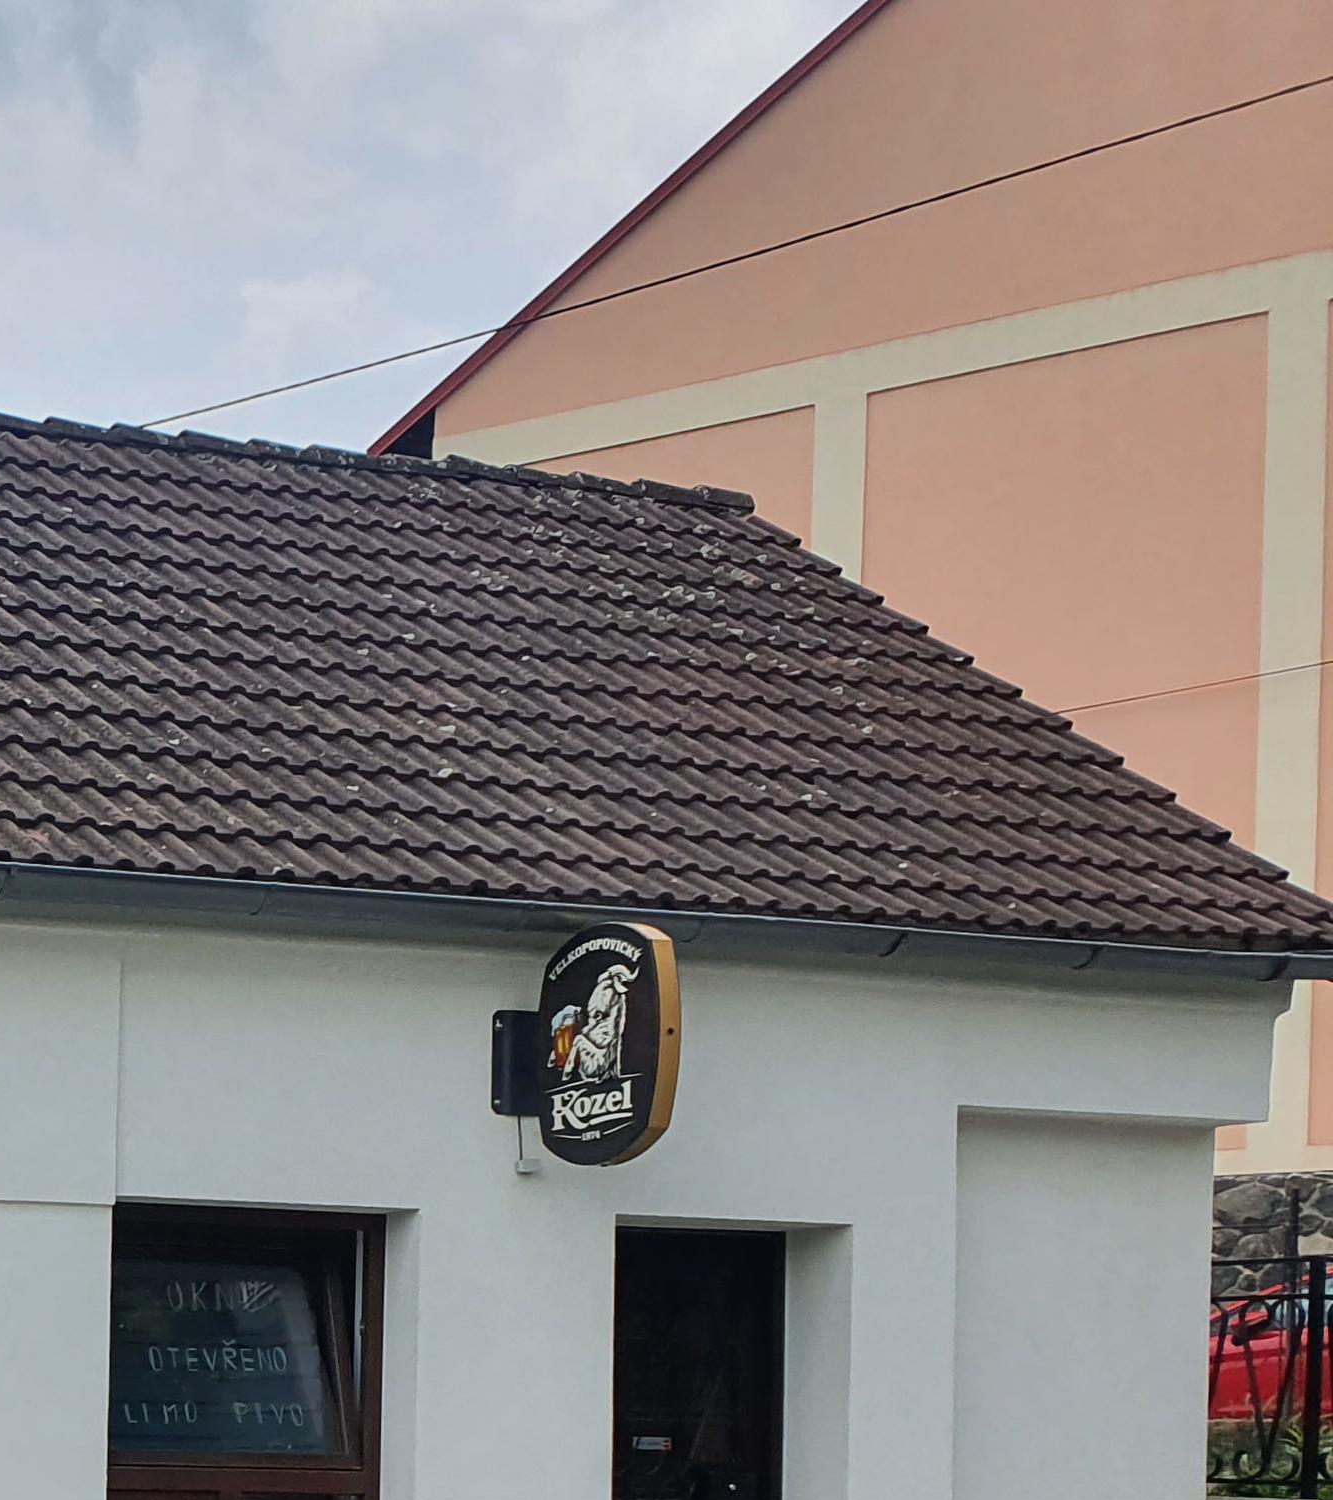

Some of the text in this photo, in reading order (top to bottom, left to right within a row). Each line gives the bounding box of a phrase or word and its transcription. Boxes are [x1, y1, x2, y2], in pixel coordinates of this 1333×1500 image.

[551, 1079, 633, 1131] Kozel
[148, 1339, 287, 1372] OTEVŘENO
[232, 1401, 305, 1427] PIVO
